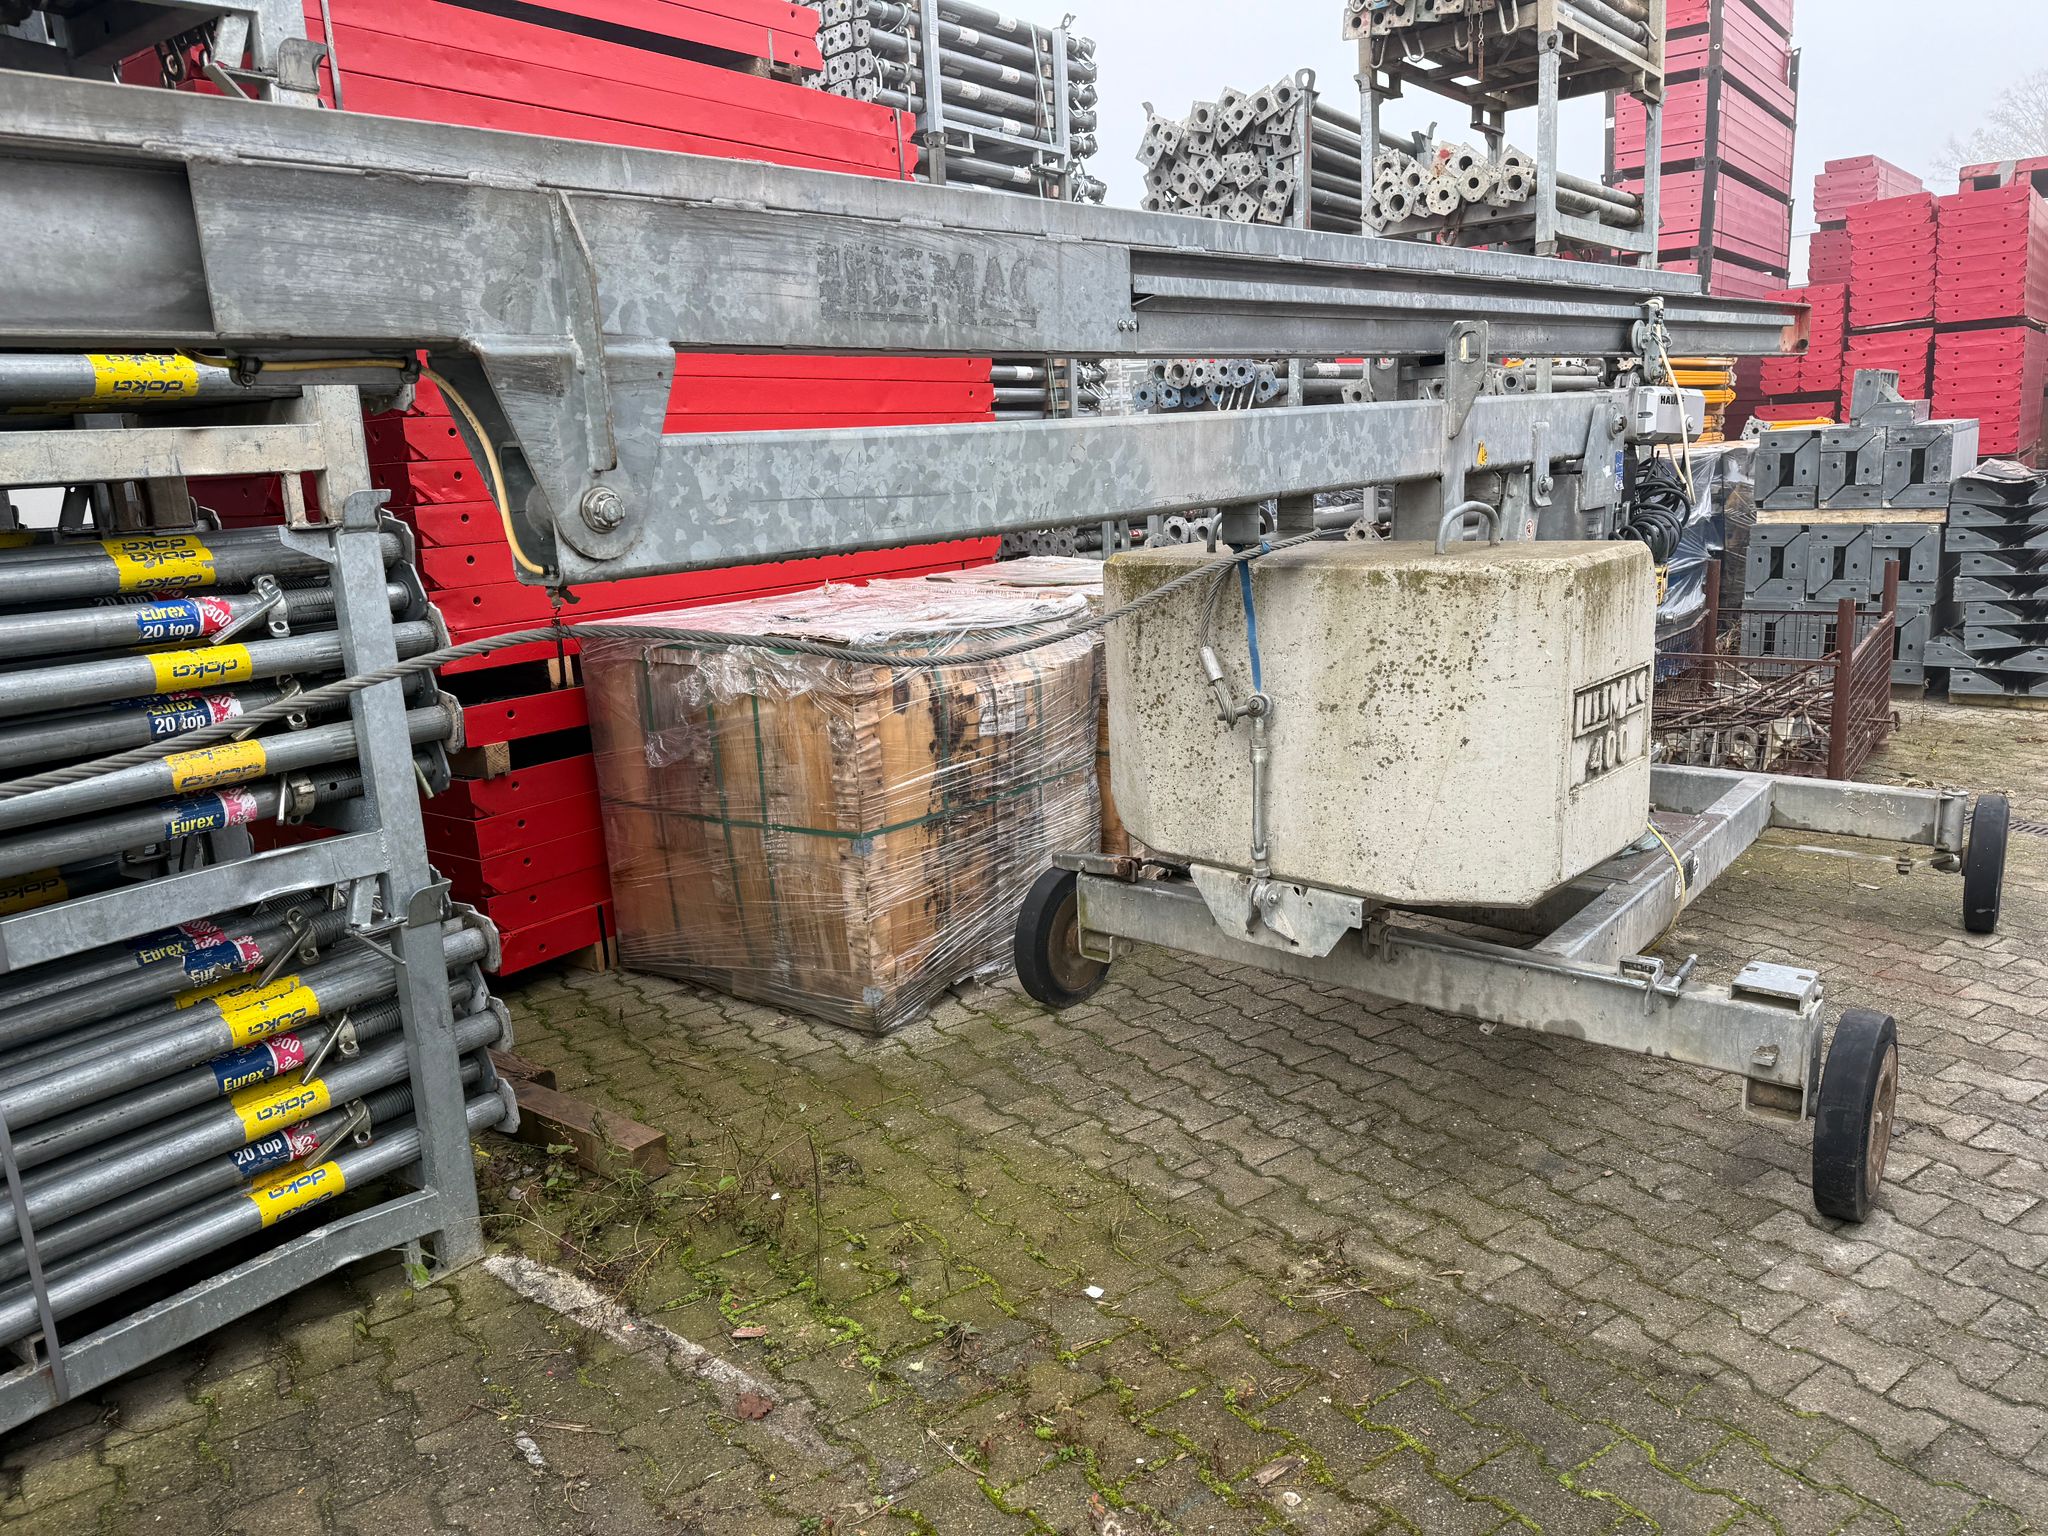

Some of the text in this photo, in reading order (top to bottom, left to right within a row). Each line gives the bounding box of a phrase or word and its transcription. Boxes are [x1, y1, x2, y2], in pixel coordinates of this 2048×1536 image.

[112, 380, 185, 394] doka
[1660, 395, 1685, 405] HAD
[122, 538, 187, 553] doka
[135, 574, 202, 588] doka
[141, 605, 188, 621] Eurex
[205, 604, 232, 628] 300
[142, 623, 195, 639] 20 top
[172, 658, 238, 678] doka
[154, 716, 176, 734] 20
[180, 714, 206, 731] top
[1588, 723, 1629, 770] 400
[171, 815, 215, 836] Eurex
[139, 942, 185, 964] Eurex
[271, 1037, 301, 1053] 300
[223, 1068, 265, 1093] Eurex
[256, 1090, 315, 1121] doka
[234, 1148, 255, 1166] 20
[258, 1138, 283, 1156] top
[268, 1168, 326, 1199] doka
